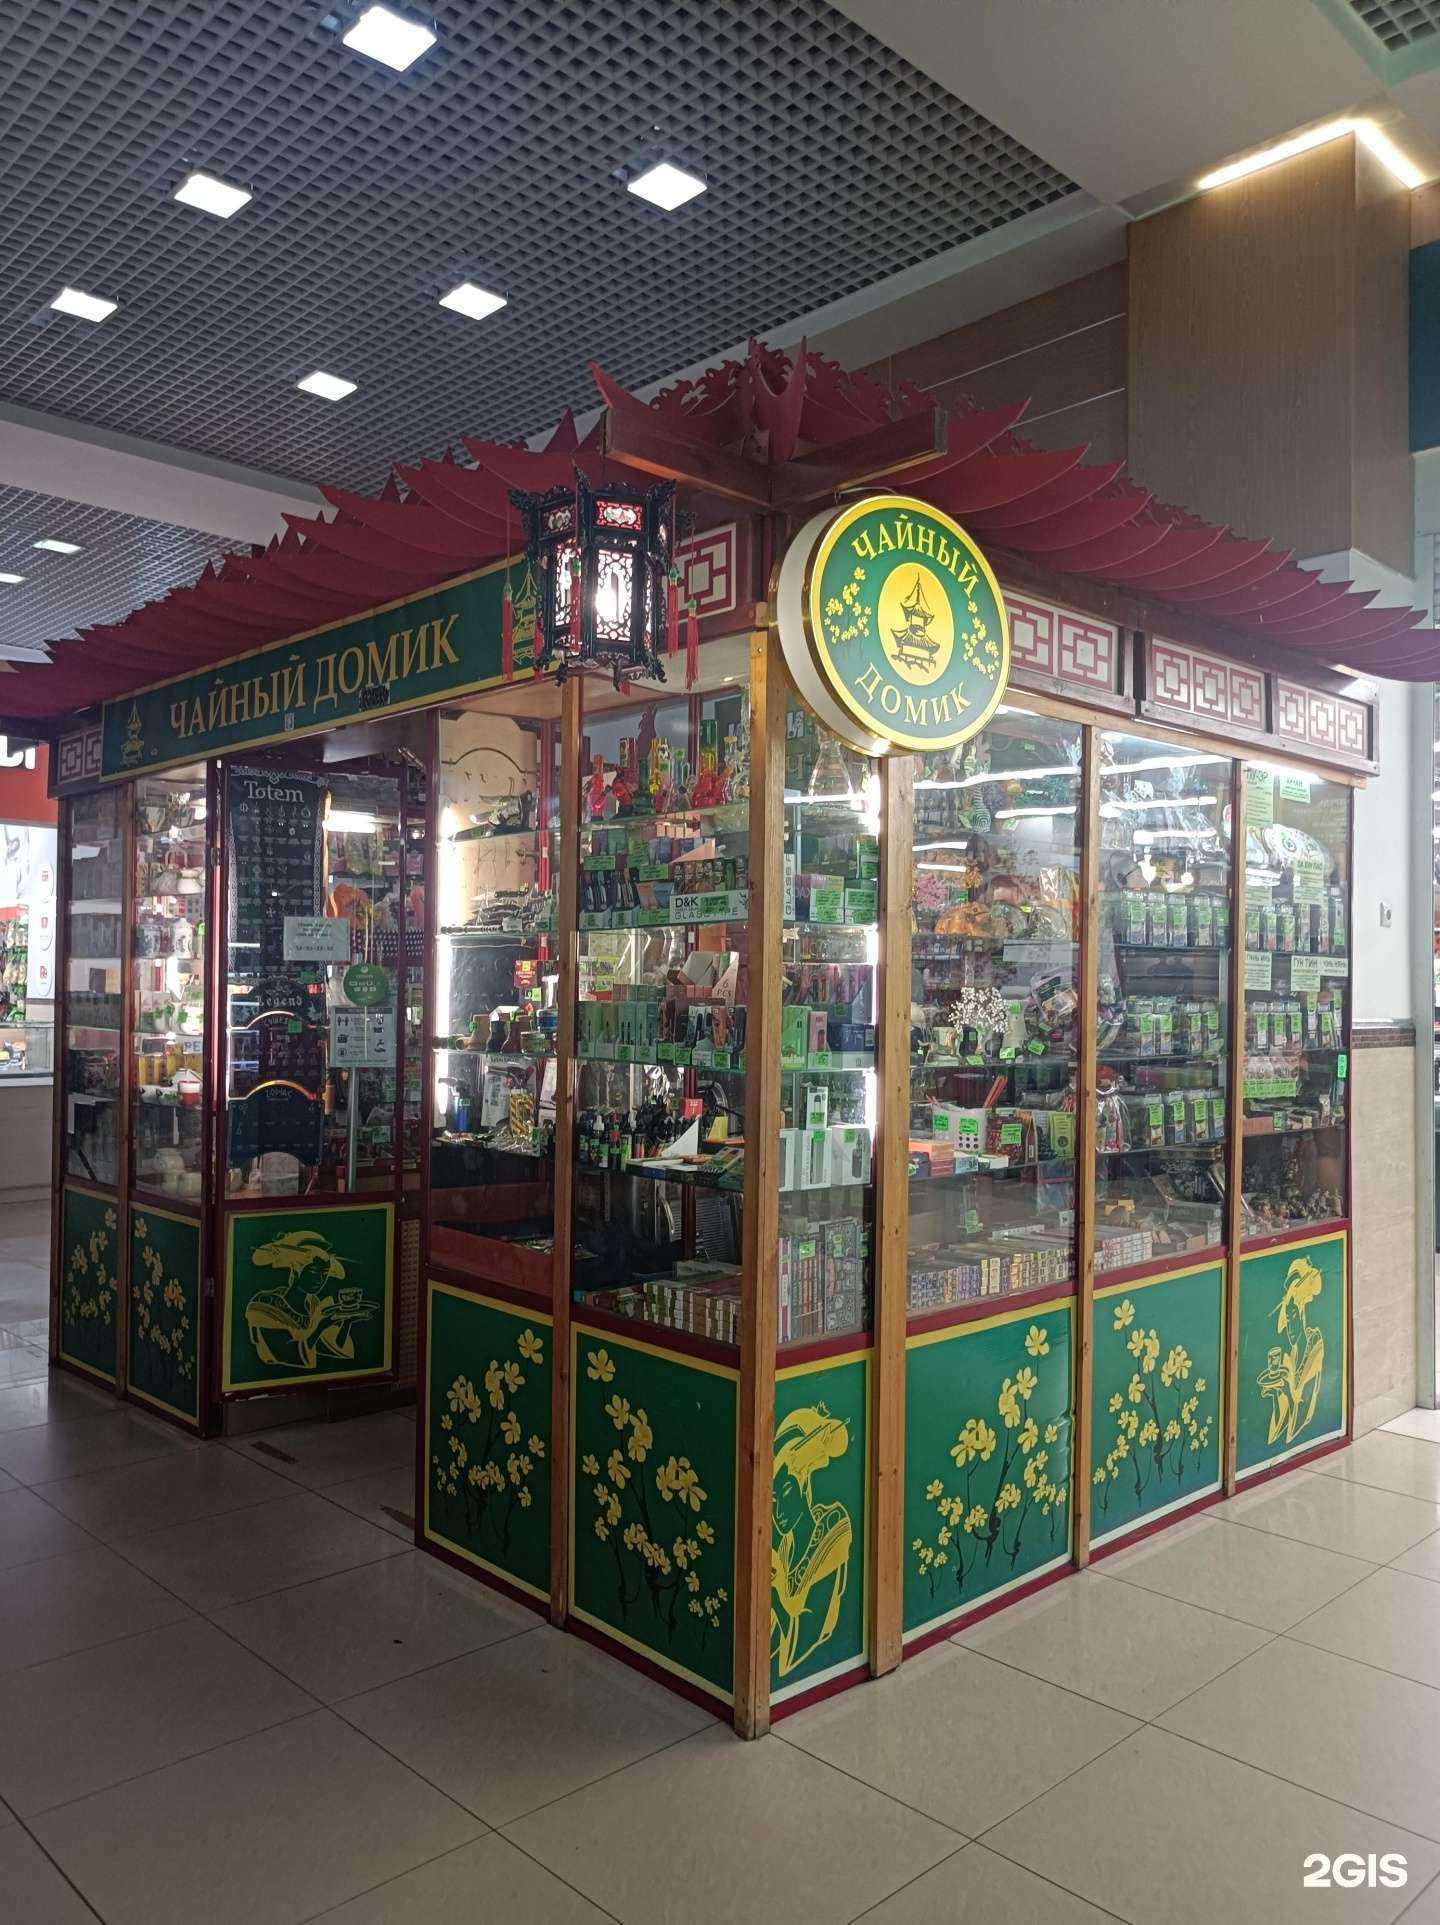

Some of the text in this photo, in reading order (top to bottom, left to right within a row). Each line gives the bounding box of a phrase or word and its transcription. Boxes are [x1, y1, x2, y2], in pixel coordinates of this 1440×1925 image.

[851, 513, 980, 599] ЧАЙНЫЙ
[169, 614, 460, 738] ЧАЙНЫЙ ДОМИК
[854, 662, 972, 726] ДОМИК
[243, 780, 304, 803] Totem
[675, 896, 699, 908] D&K
[255, 995, 303, 1007] Legend
